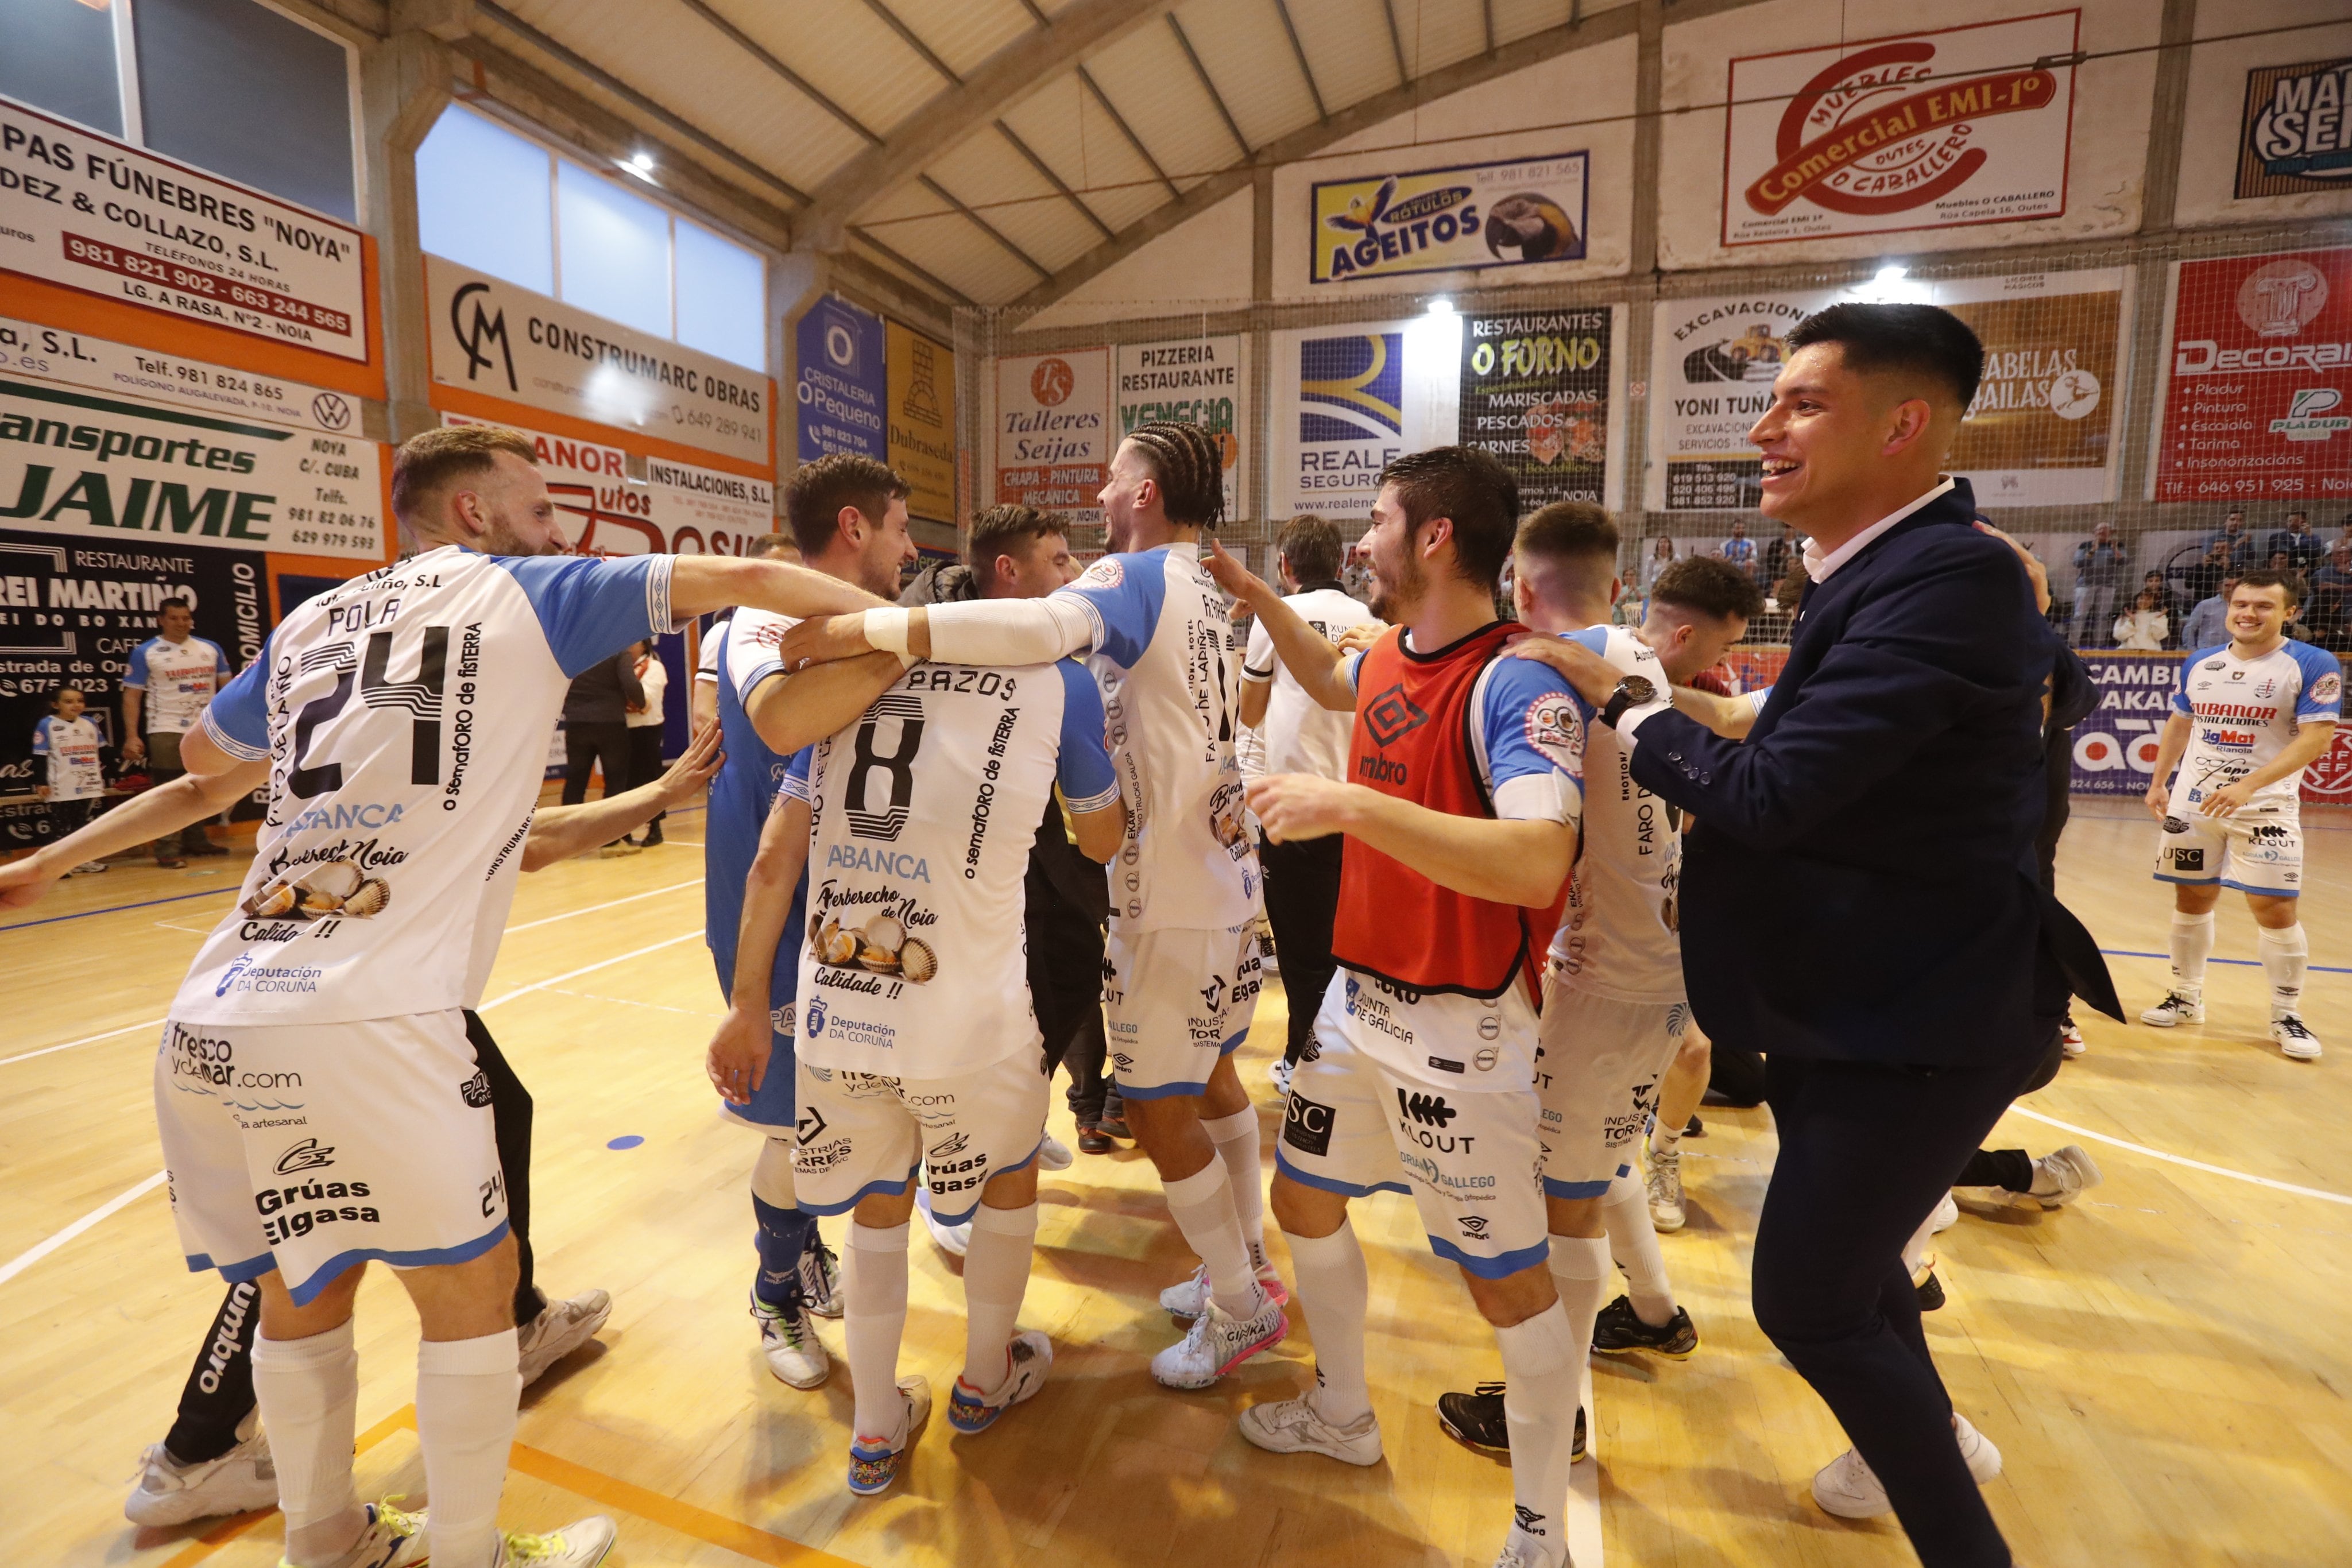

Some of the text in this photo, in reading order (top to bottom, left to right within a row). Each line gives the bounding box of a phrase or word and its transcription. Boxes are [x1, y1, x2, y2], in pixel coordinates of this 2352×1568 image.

[1810, 65, 1932, 127] MUEBLES
[1758, 105, 1919, 203] Comercial
[1853, 124, 1974, 194] CABALLERO
[1875, 139, 1925, 165] OUTES
[86, 154, 256, 233] FÚNEBRES
[263, 214, 350, 262] "NOYA"
[1935, 190, 2055, 211] Muebles CABALLERO
[2017, 202, 2049, 213] Outes
[72, 190, 95, 215] &
[104, 201, 233, 260] COLLAZO,
[238, 244, 280, 272] S.L.
[1330, 203, 1481, 280] AGEITOS
[69, 238, 347, 332] 981 821 902 663 244 565
[229, 265, 245, 280] 24
[248, 270, 291, 294] HORAS
[123, 280, 153, 301] LG.
[159, 291, 172, 306] A
[177, 295, 230, 323] RASA,
[276, 323, 313, 343] NOIA
[1472, 312, 1603, 338] RESTAURANTES
[42, 331, 98, 363] S.L.
[1141, 344, 1215, 367] PIZZERIA
[1471, 335, 1602, 378] O FORNO
[528, 316, 760, 413] CONSTRUMARC OBRAS
[136, 356, 283, 401] Telf. 981 824 865
[1121, 366, 1235, 392] RESTAURANTE
[2195, 382, 2245, 396] Pladur
[1488, 389, 1598, 409] MARISCADAS
[1675, 397, 1719, 416] YONI
[2193, 402, 2247, 415] Pintura
[687, 405, 761, 443] 649 289 941
[1005, 410, 1101, 435] Talleres
[1477, 413, 1565, 430] PESCADOS
[2191, 420, 2253, 433] Escaiola
[2271, 419, 2350, 431] PLADUR
[312, 438, 346, 457] NOYA
[1014, 439, 1091, 464] Seijas
[1678, 438, 1731, 451] SERVICIOS
[2189, 438, 2240, 452] Tarima
[324, 462, 359, 480] CUBA
[2187, 454, 2304, 470] Insonorizacións
[650, 463, 771, 504] INSTALACIONES, S.L.
[1004, 467, 1100, 487] CHAPA PINTURA
[2198, 478, 2304, 494] 646 951 925
[0, 463, 277, 543] JAIME
[1562, 489, 1597, 502] NOIA
[1076, 510, 1101, 522] NOIA
[292, 530, 374, 550] 629 979 593
[75, 549, 195, 574] RESTAURANTE
[328, 598, 401, 637] POLA
[68, 660, 94, 673] de
[1197, 619, 1209, 710] DE LARIÑO
[906, 669, 1017, 702] PAZOS
[287, 626, 450, 800] 24
[844, 695, 925, 842] 8
[1125, 752, 1138, 781] GALICIA
[1132, 782, 1143, 813] TRUCKS
[1127, 808, 1136, 840] EKAM
[1638, 804, 1653, 855] FARO
[2164, 847, 2200, 862] USC
[2249, 837, 2295, 848] KLOUT
[828, 844, 931, 883] ABANCA
[881, 897, 938, 930] de Noia
[256, 978, 317, 992] CORUÑA
[814, 966, 882, 996] Calidade
[1361, 990, 1390, 1019] XUNTA
[829, 1028, 893, 1050] DA CORUÑA
[830, 1015, 896, 1037] Deputación
[1368, 1013, 1413, 1045] GALICIA
[253, 1116, 308, 1128] artesanal
[1399, 1118, 1475, 1155] KLOUT
[479, 1169, 506, 1218] 24
[1441, 1174, 1496, 1188] GALLEGO
[256, 1178, 371, 1215] Grúas
[263, 1205, 380, 1246] Elgasa
[1462, 1230, 1490, 1241] umbro
[199, 1281, 257, 1394] umbro
[1227, 1323, 1266, 1342] GINKA
